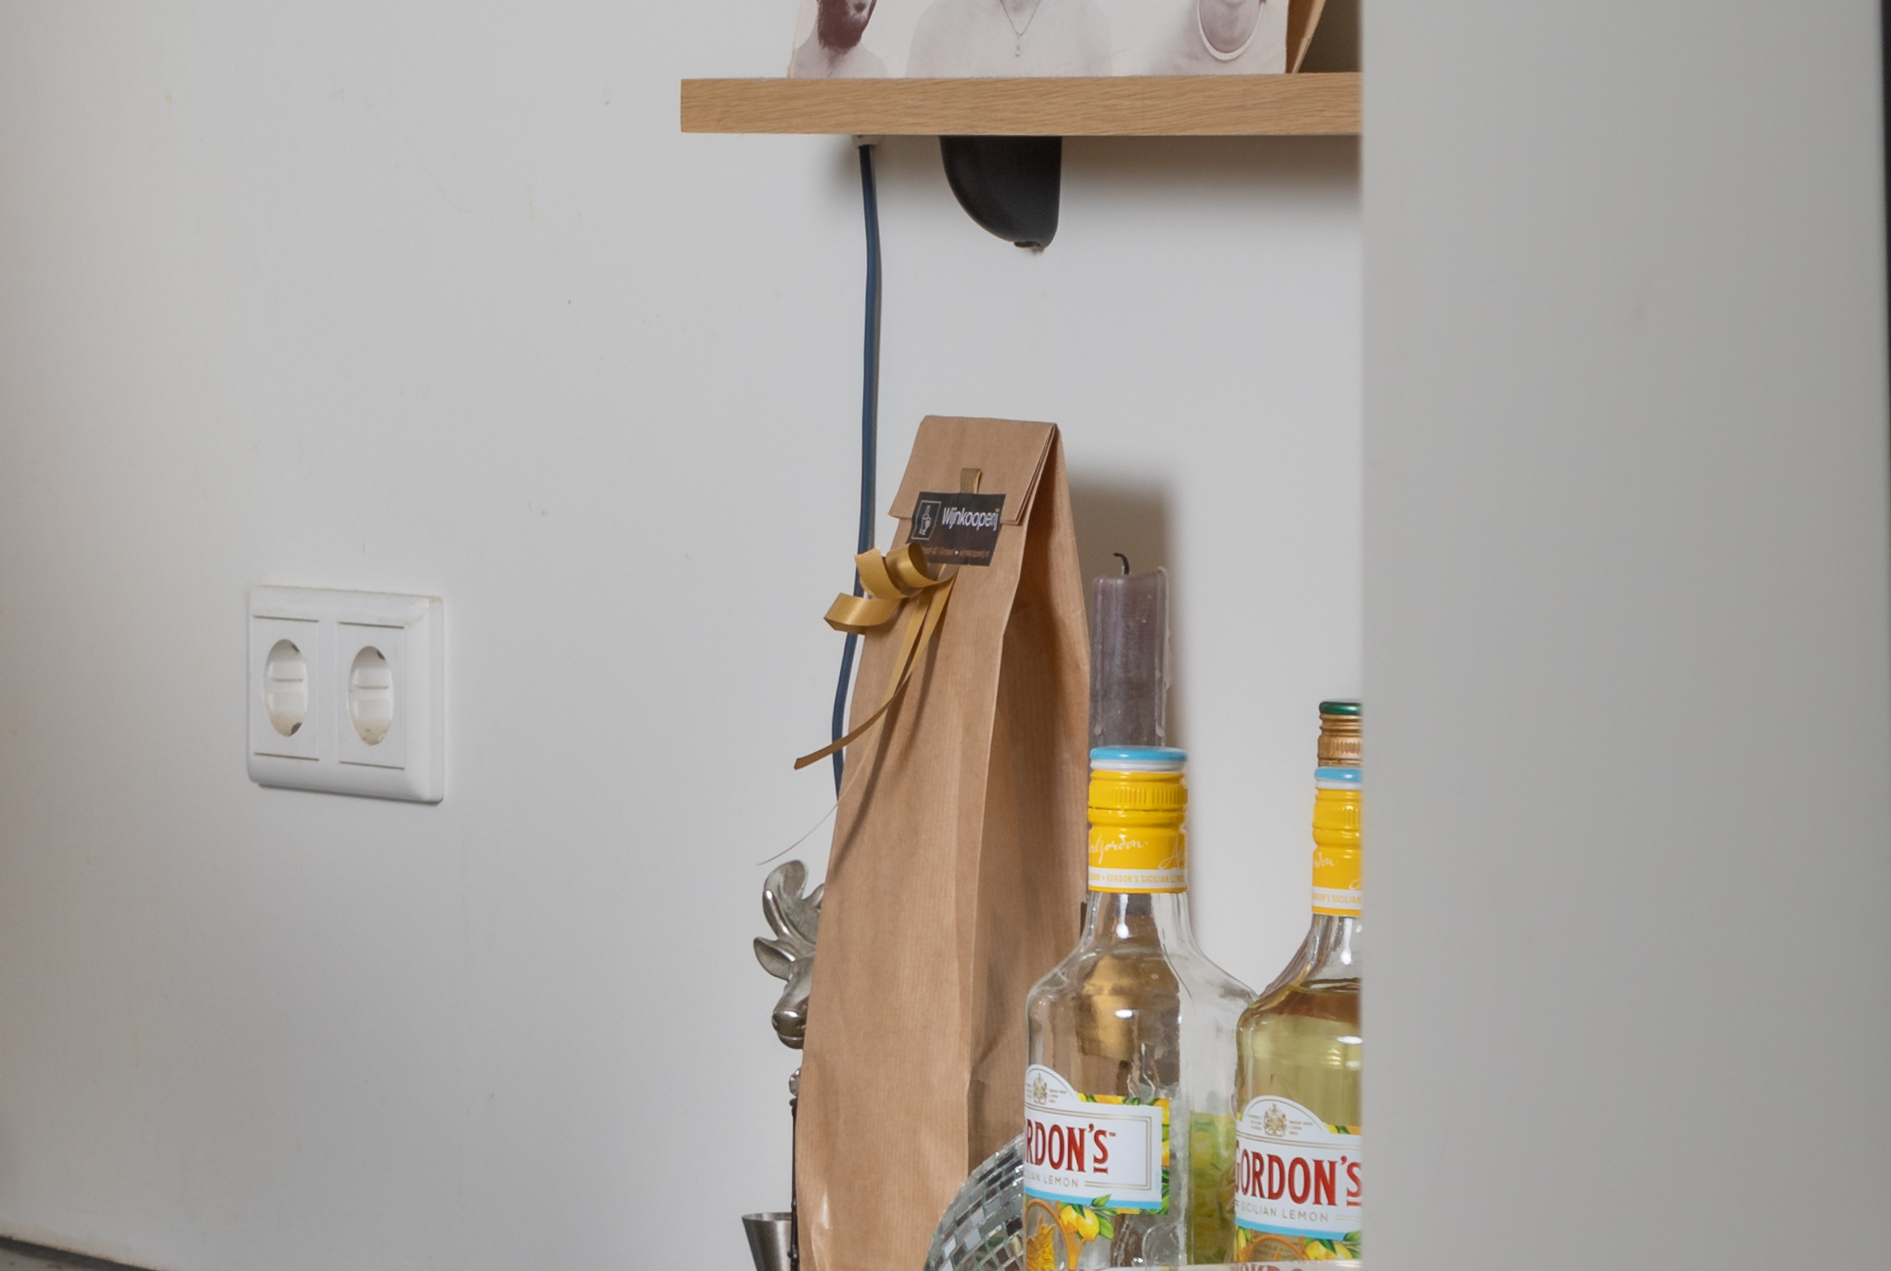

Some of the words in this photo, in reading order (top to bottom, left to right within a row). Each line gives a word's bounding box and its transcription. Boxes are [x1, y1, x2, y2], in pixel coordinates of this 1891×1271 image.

[1026, 1118, 1109, 1174] RDON'S
[1042, 1174, 1079, 1188] LEMON
[1236, 1139, 1362, 1206] ORDON'S
[1240, 1200, 1278, 1217] SICILIAN
[1281, 1208, 1329, 1223] LEMON
